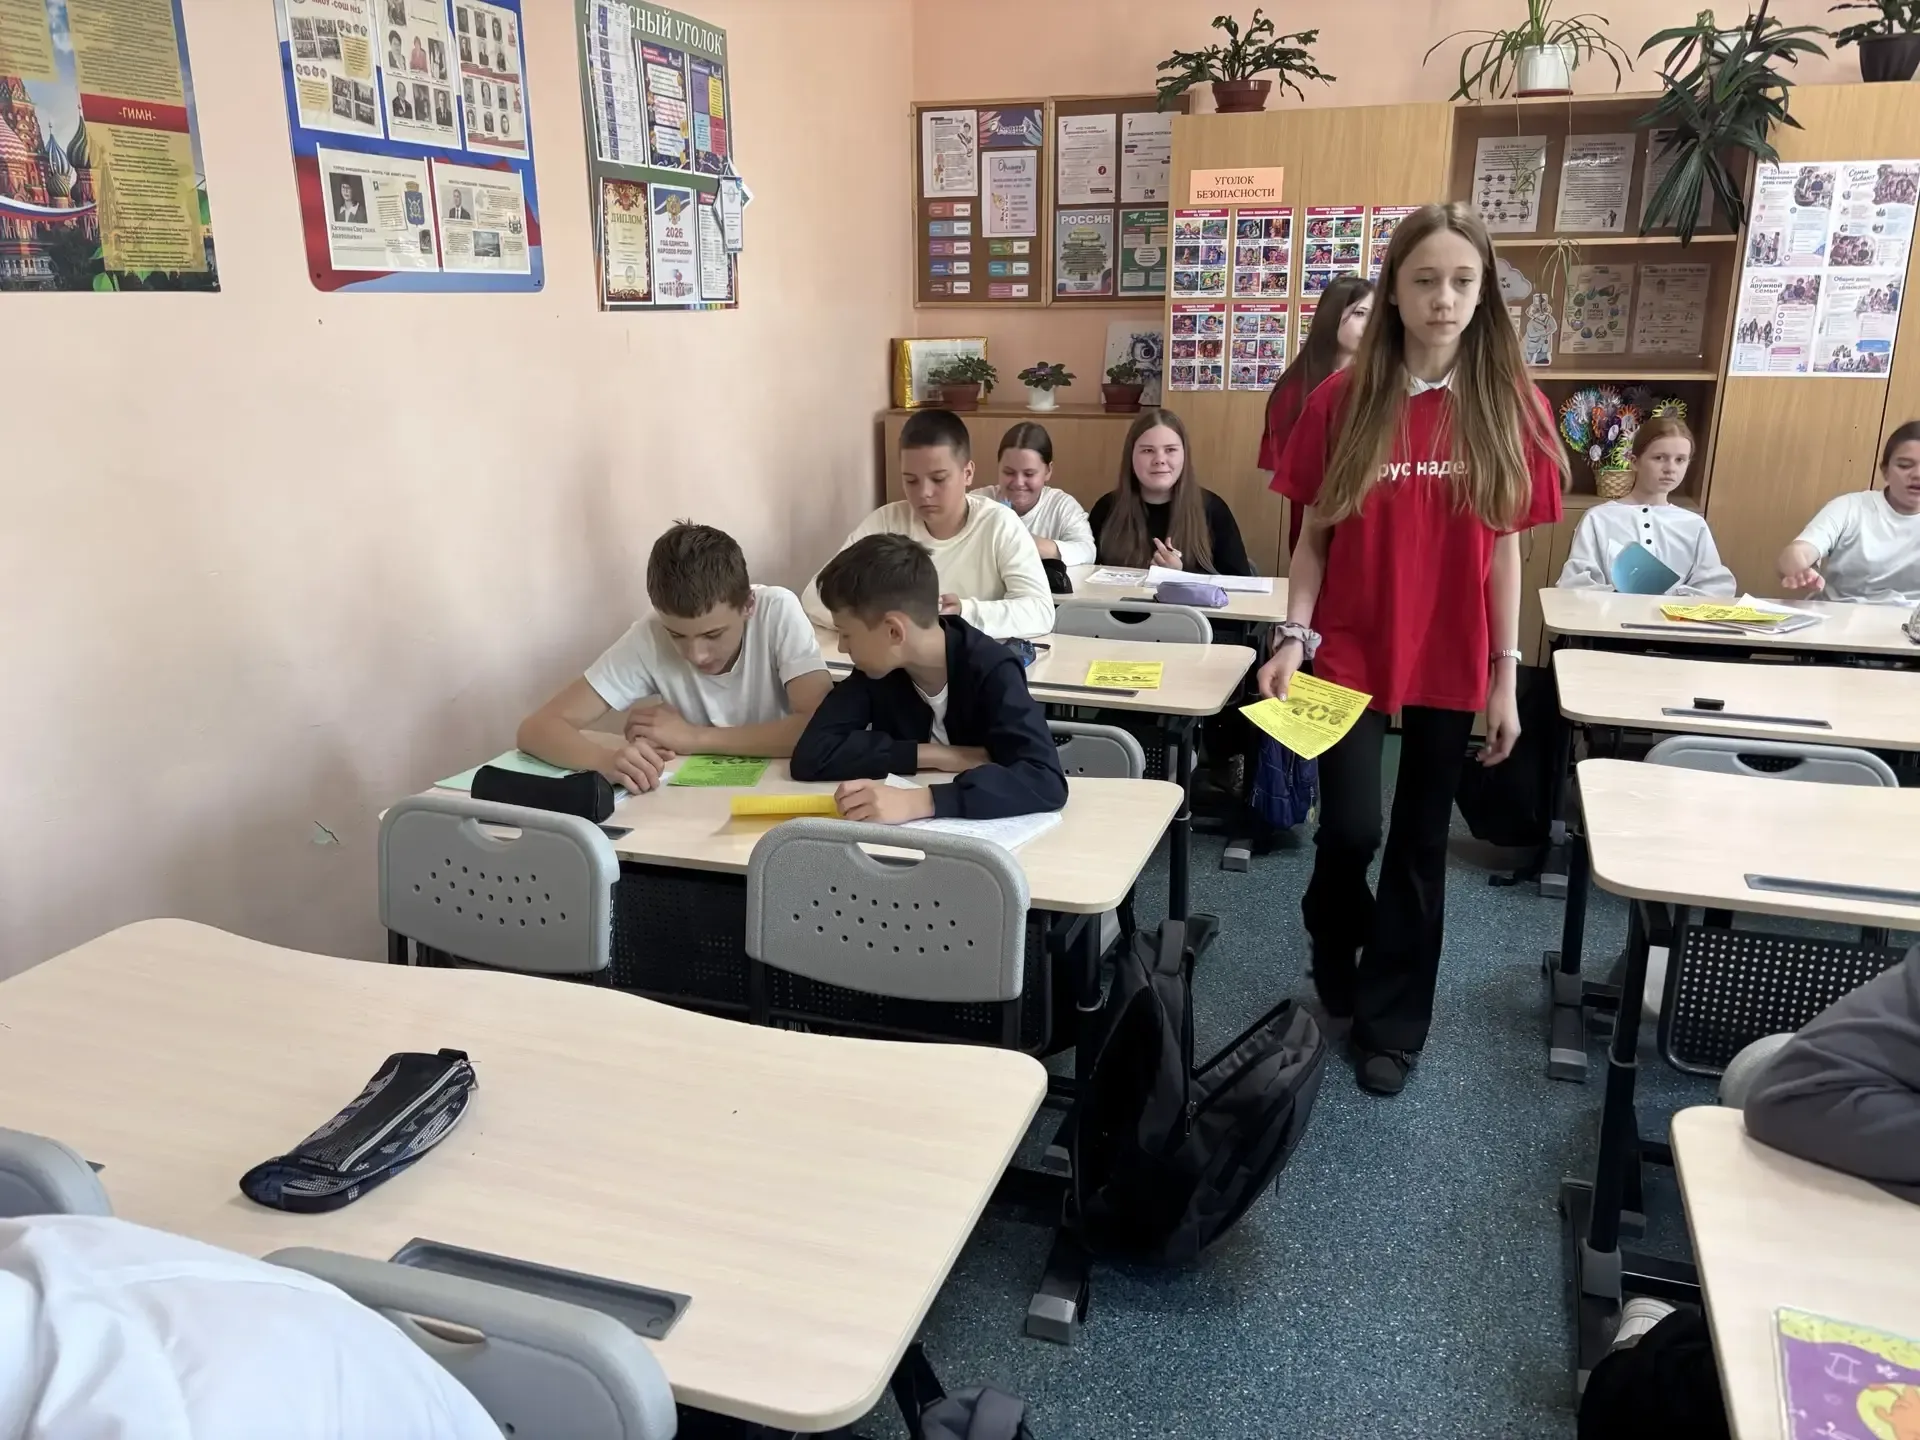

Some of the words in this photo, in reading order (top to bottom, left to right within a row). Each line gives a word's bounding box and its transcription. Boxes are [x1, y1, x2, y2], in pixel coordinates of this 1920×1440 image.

[676, 19, 722, 55] УГОЛОК
[1215, 176, 1254, 185] УГОЛОК
[1197, 189, 1275, 198] БЕЗОПАСНОСТИ
[611, 213, 642, 225] ДИПЛОМ
[1060, 214, 1111, 225] РОССИЯ
[665, 226, 684, 239] 2026
[1416, 460, 1468, 478] наде
